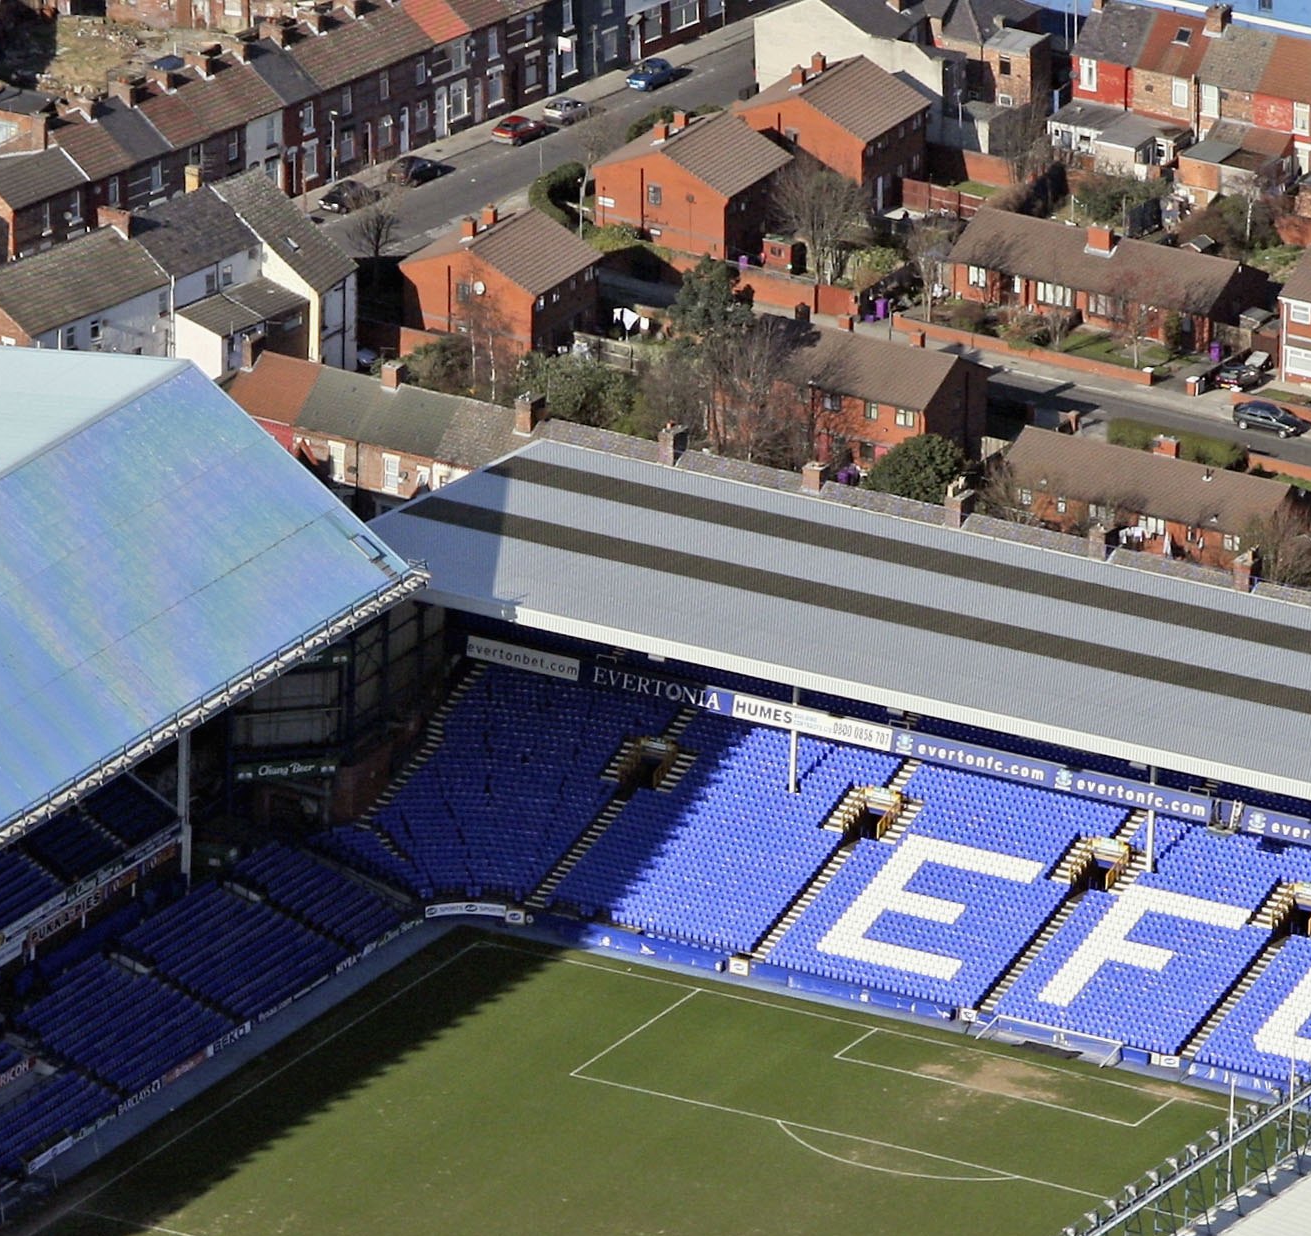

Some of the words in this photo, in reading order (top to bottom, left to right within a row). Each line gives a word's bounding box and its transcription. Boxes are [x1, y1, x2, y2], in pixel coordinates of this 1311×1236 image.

[466, 642, 579, 678] evertonbet.com
[591, 665, 722, 712] EVERTONIA
[735, 700, 793, 724] HUMES
[917, 740, 1046, 782] evertonfc.com
[1075, 777, 1207, 818] evertonfc.com
[0, 1060, 30, 1087] RICOH
